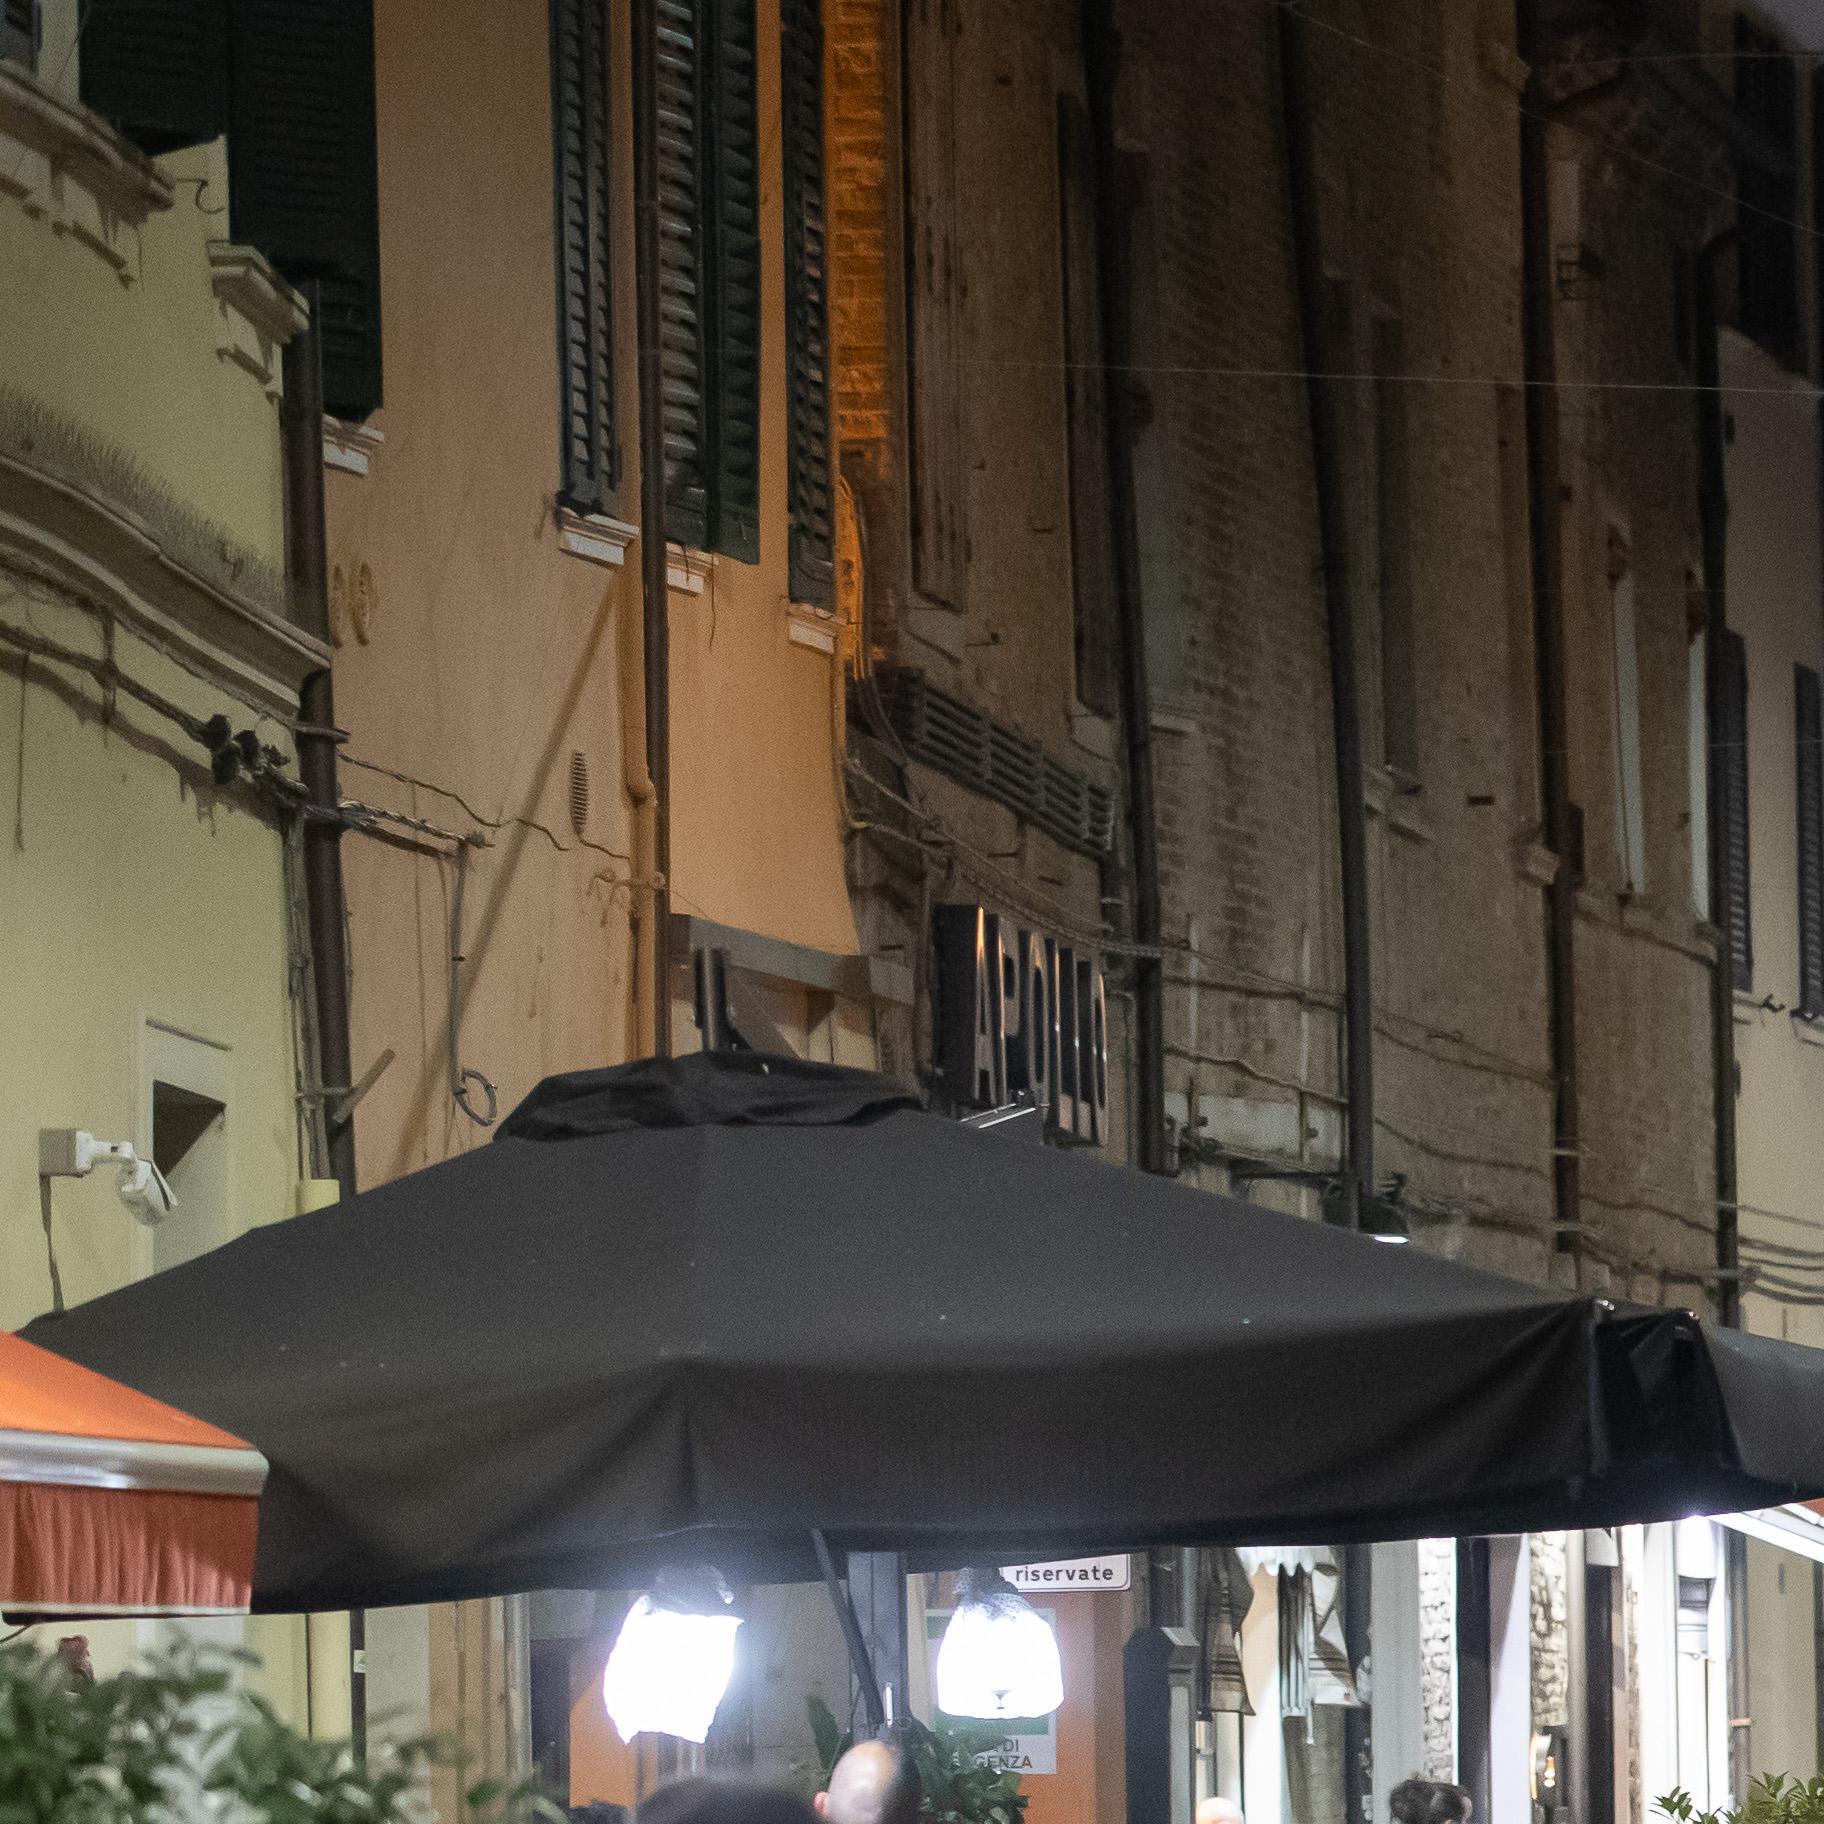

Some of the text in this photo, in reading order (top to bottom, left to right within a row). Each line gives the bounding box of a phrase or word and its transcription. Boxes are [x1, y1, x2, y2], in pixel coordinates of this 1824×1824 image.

[940, 903, 1109, 1147] APOLLO
[1015, 1563, 1113, 1581] riservate
[1002, 1738, 1019, 1753] DI
